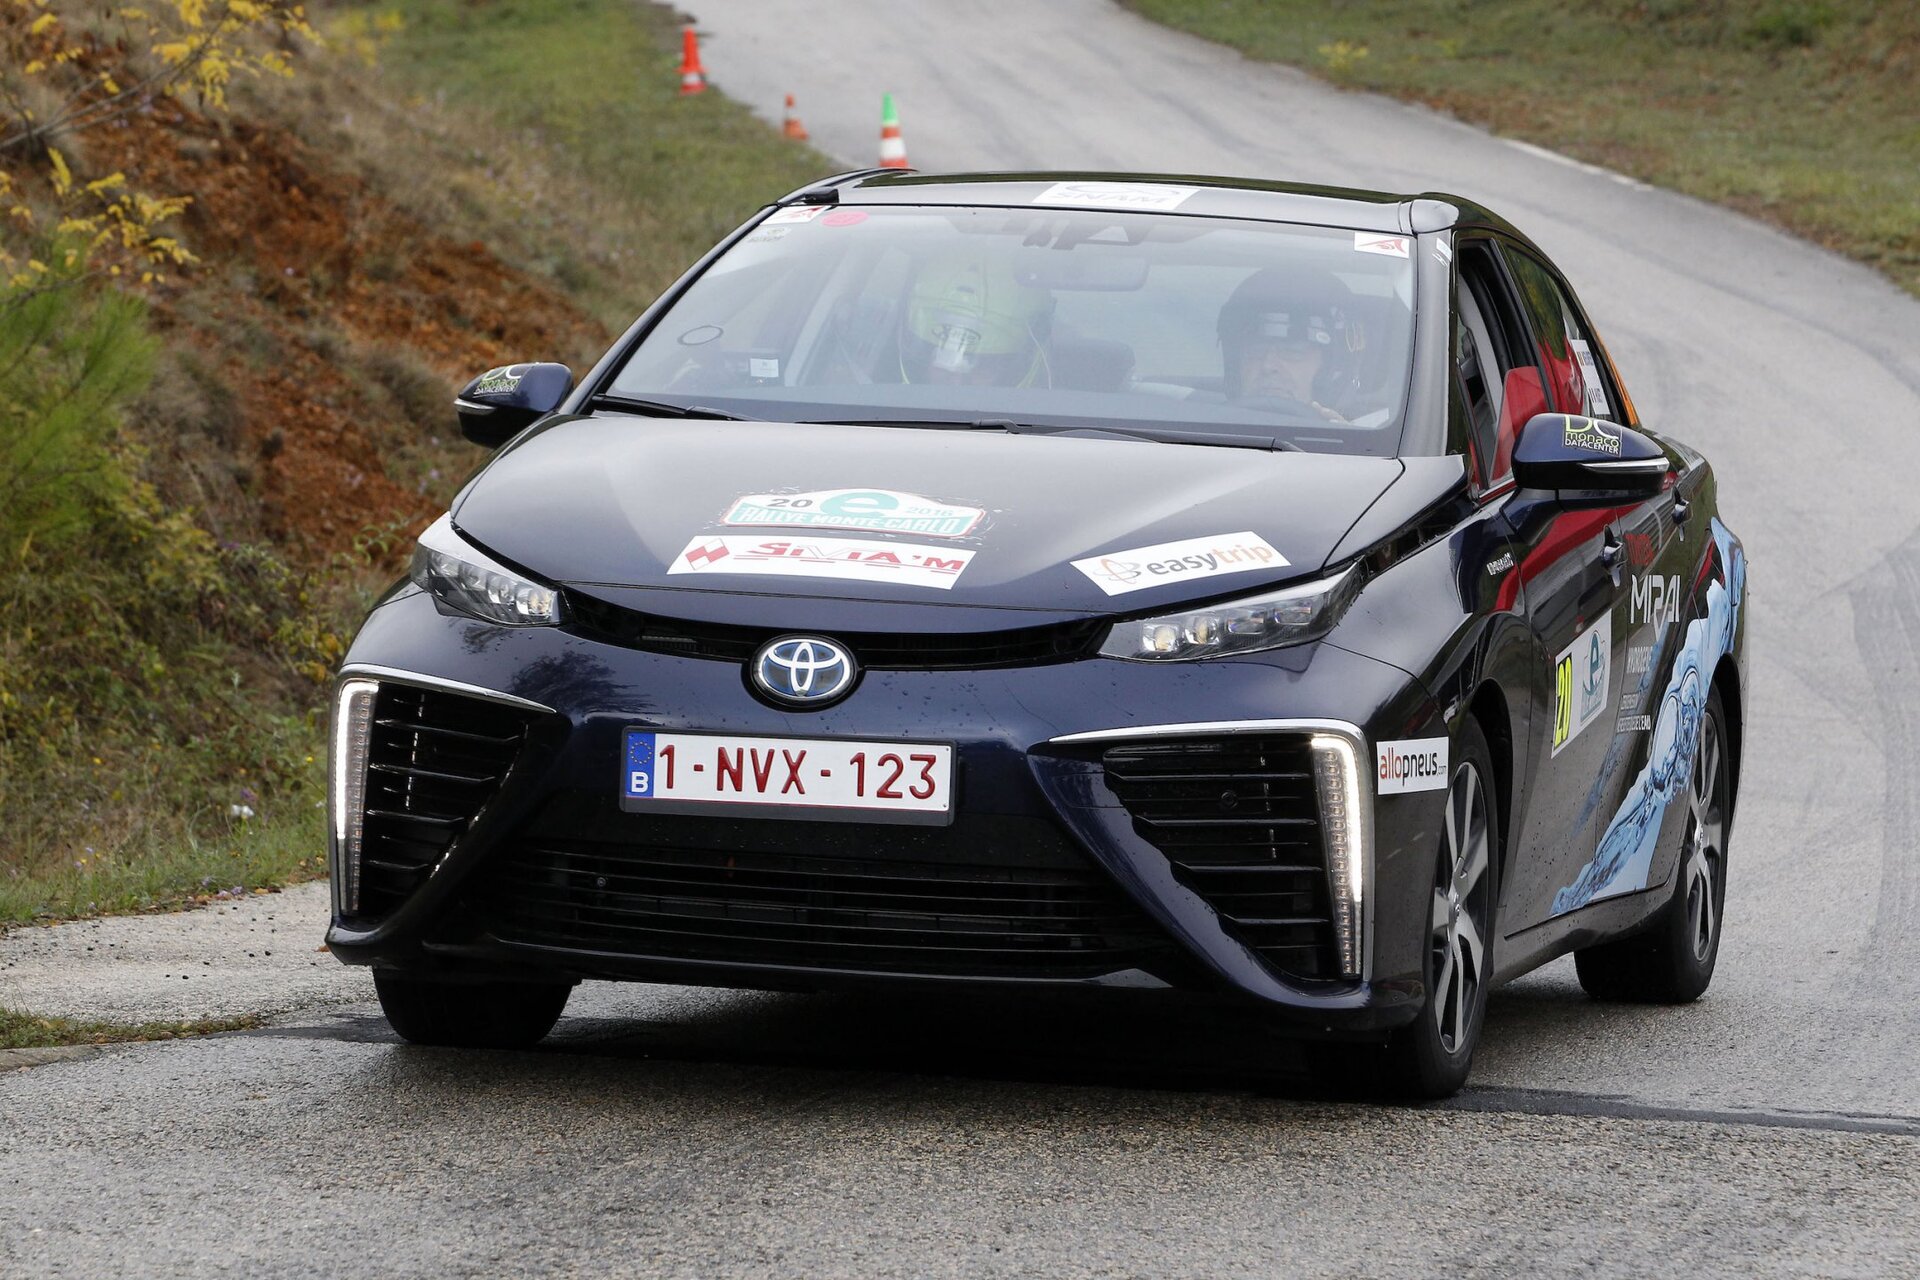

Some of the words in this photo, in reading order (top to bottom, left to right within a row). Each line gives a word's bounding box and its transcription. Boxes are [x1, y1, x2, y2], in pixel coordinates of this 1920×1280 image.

[1564, 438, 1620, 455] DATACENTER
[1565, 432, 1620, 448] monaco
[738, 507, 809, 524] RALLYE
[811, 515, 961, 534] MONTE-CARLO
[767, 498, 814, 508] 20
[906, 506, 956, 517] 2016
[1146, 544, 1273, 575] easytrip
[1630, 574, 1681, 642] MIRAI
[1554, 656, 1573, 747] 20
[631, 771, 649, 793] B
[659, 744, 938, 800] 1-NVX-123
